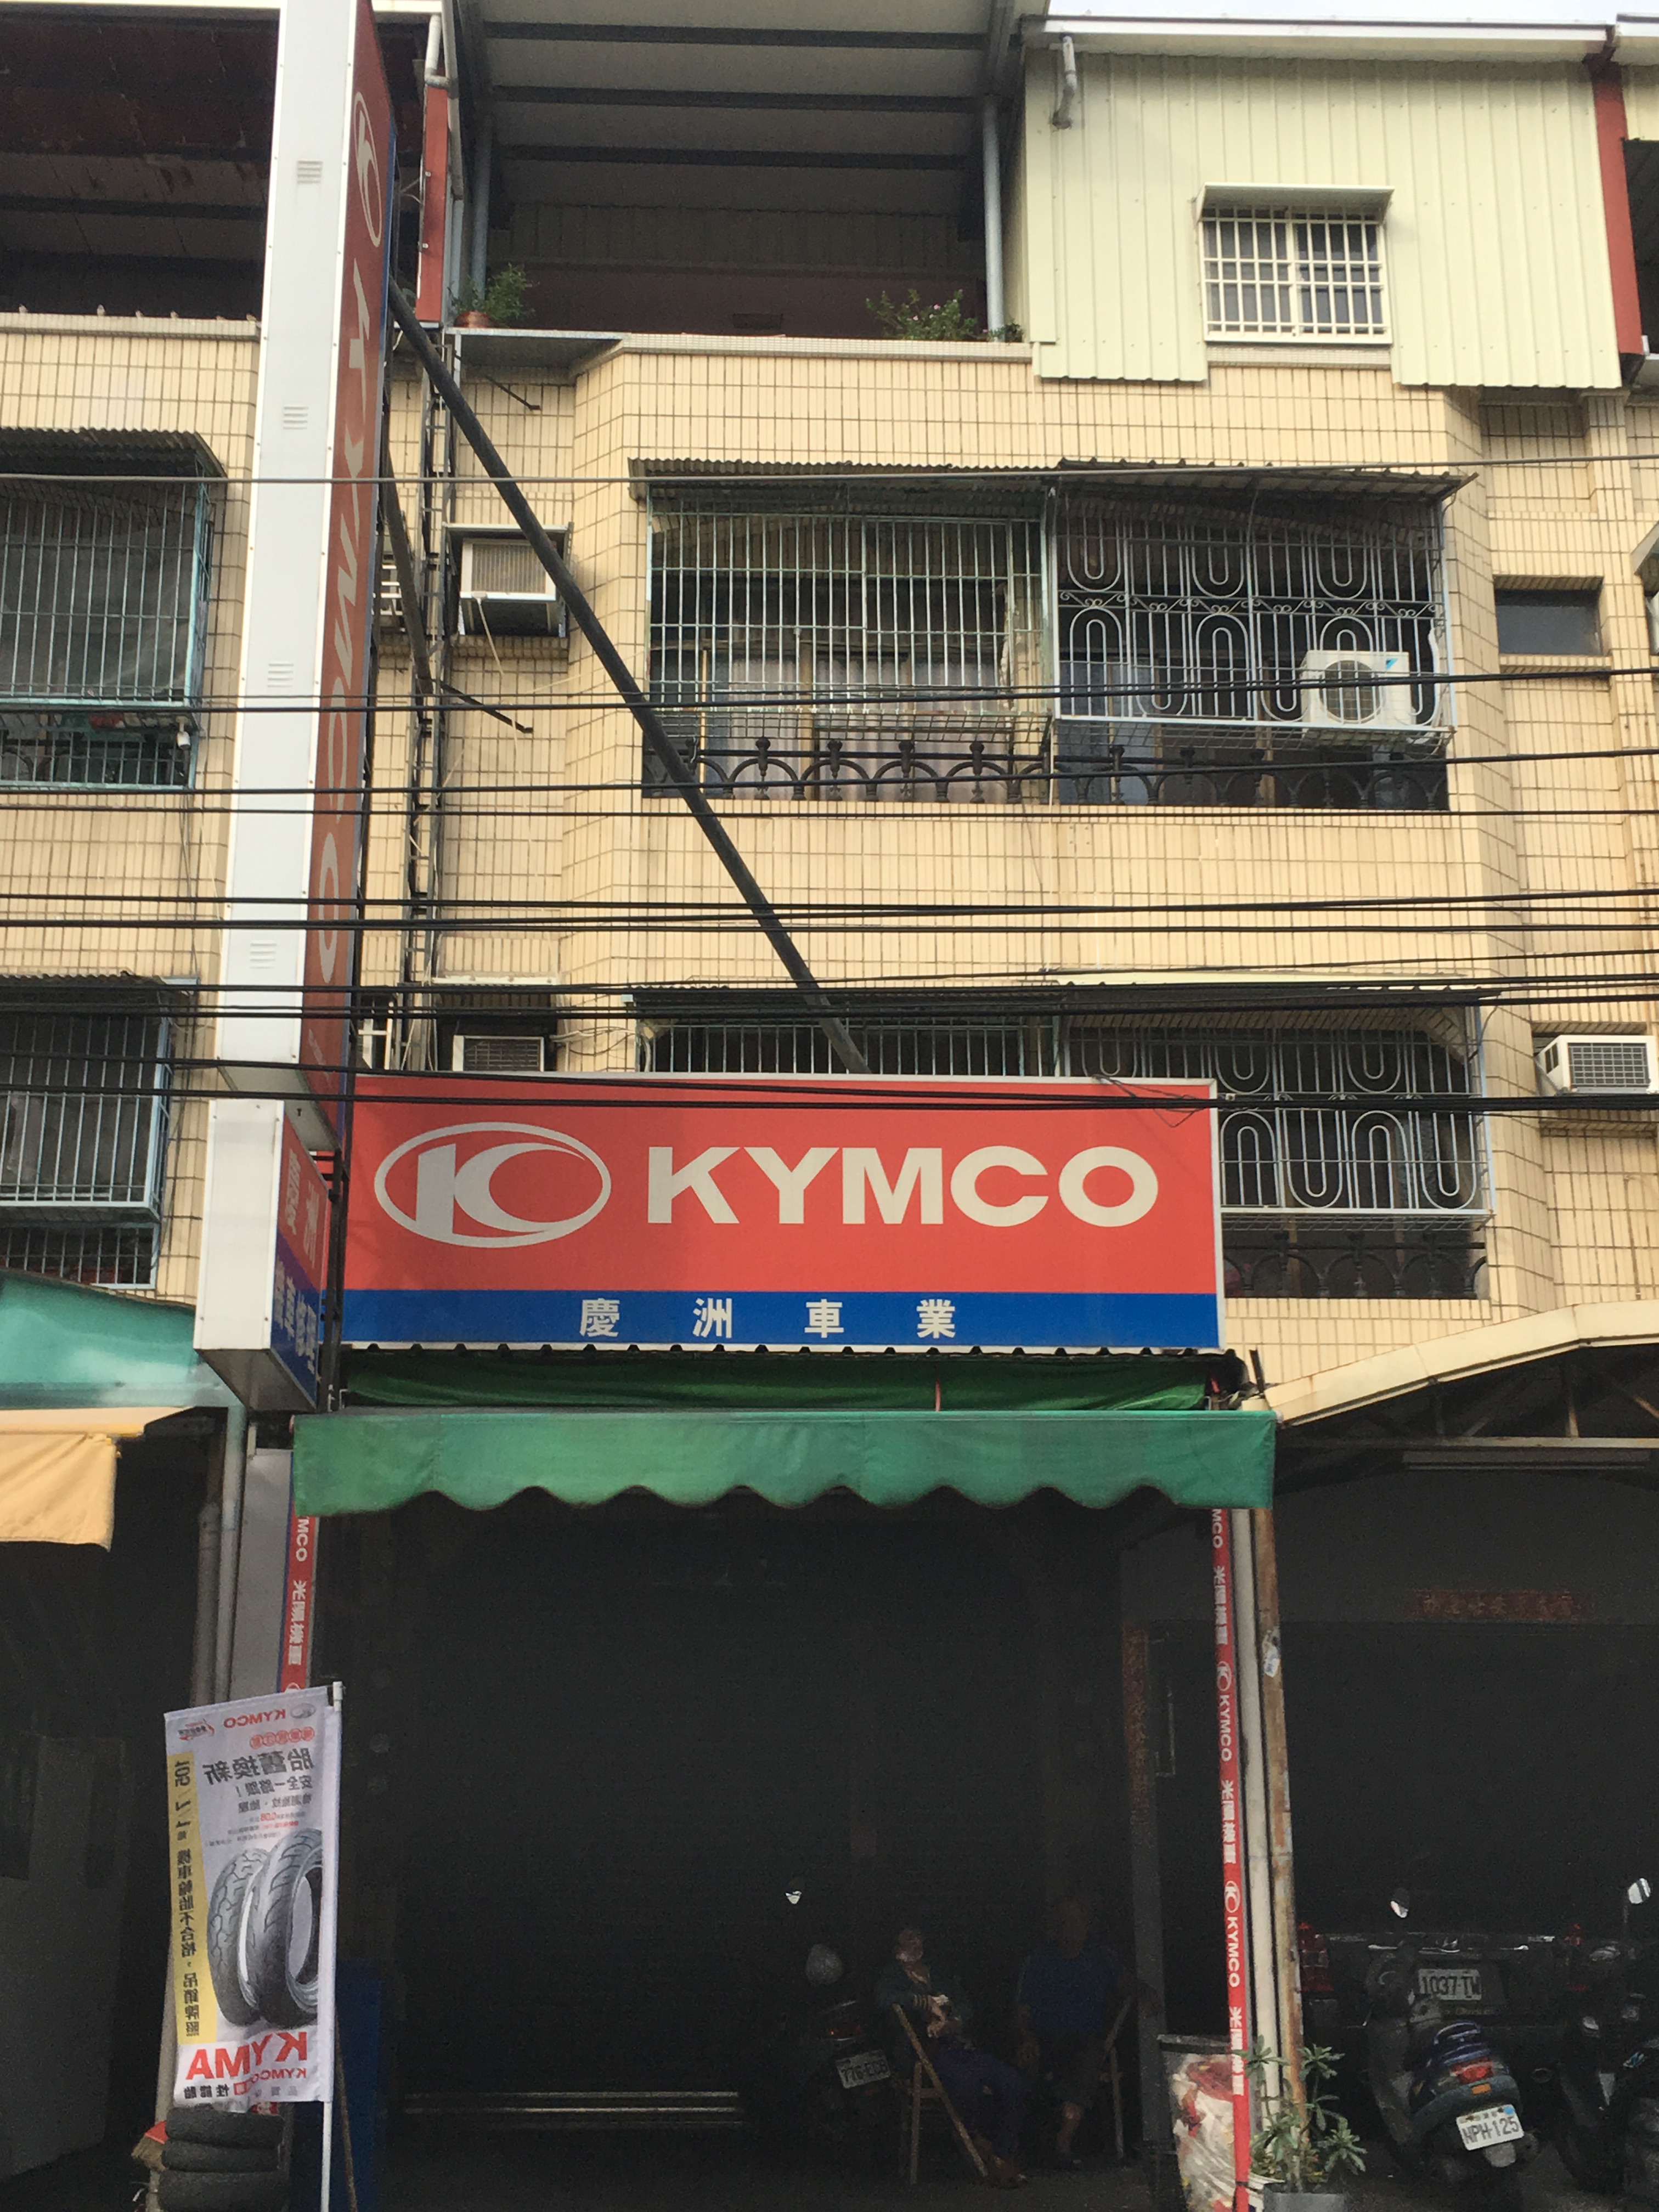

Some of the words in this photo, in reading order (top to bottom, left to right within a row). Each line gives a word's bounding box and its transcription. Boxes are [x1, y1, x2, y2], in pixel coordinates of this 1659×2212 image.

[319, 258, 370, 983] KYMCO
[648, 1146, 1159, 1227] KYMCO
[579, 1298, 956, 1339] 慶洲車業
[295, 1516, 309, 1562] MCO
[1212, 1509, 1223, 1549] MCO
[1218, 1695, 1232, 1762] KYMCO
[1227, 1916, 1241, 1987] KYMCO
